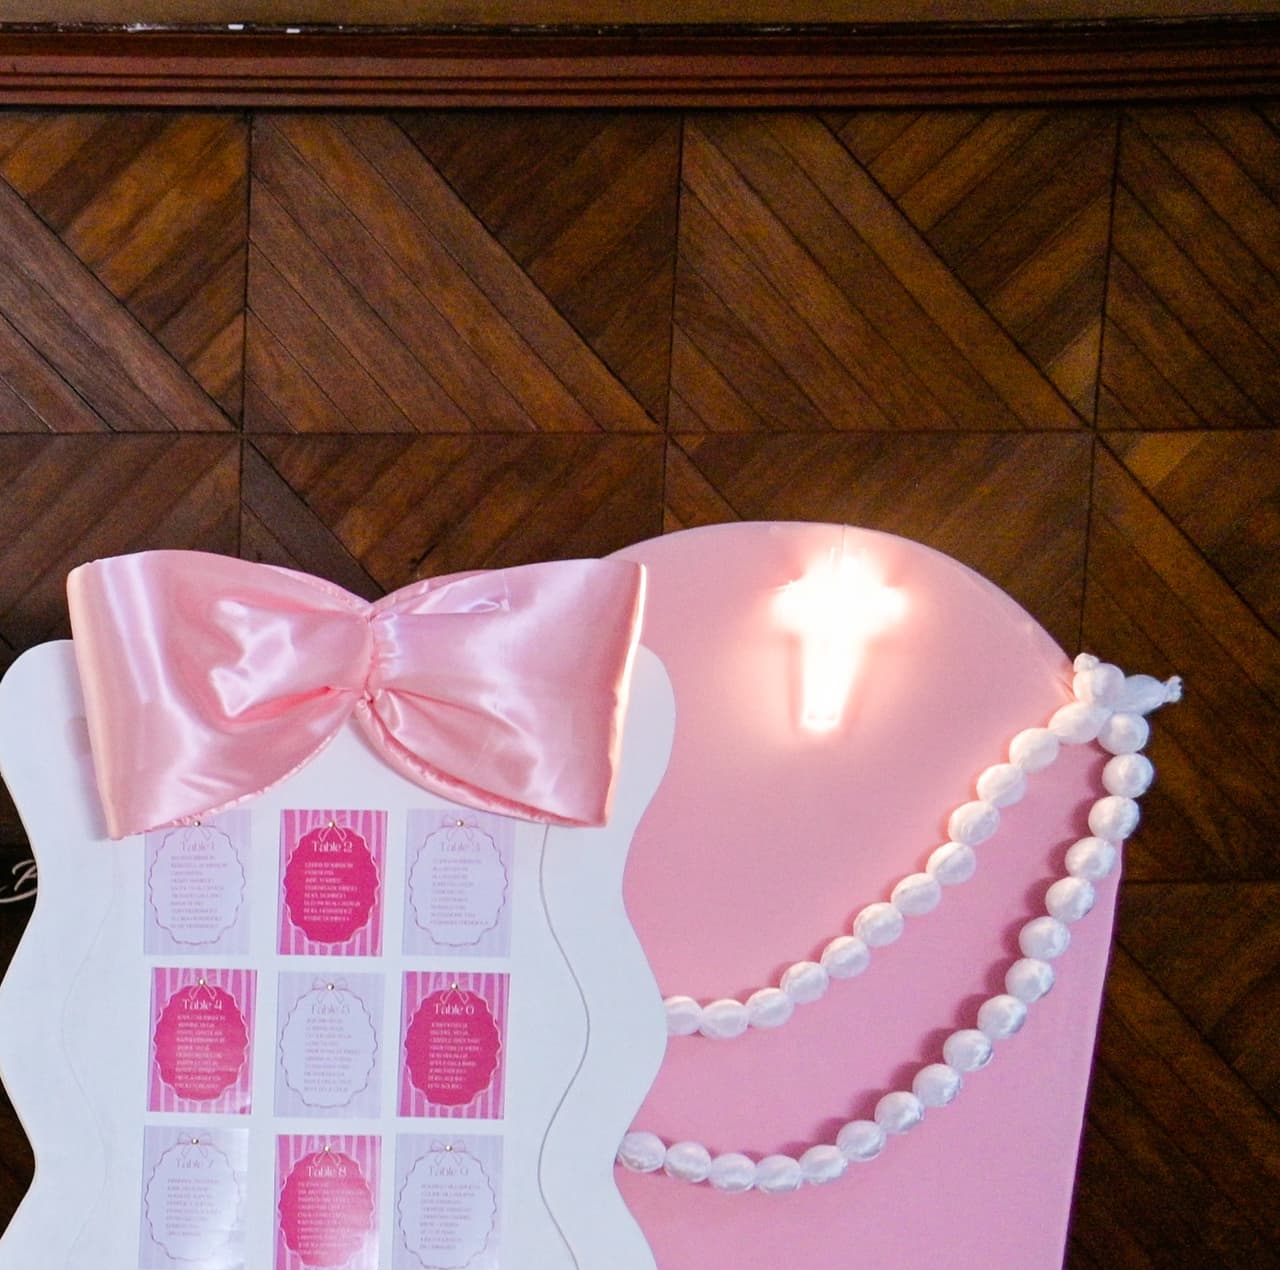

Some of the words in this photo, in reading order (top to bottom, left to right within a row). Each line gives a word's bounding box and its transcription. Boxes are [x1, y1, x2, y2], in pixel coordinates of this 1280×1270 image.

[311, 841, 341, 853] Table
[182, 999, 212, 1010] Table
[434, 1003, 464, 1015] Table
[307, 1166, 337, 1177] Table
